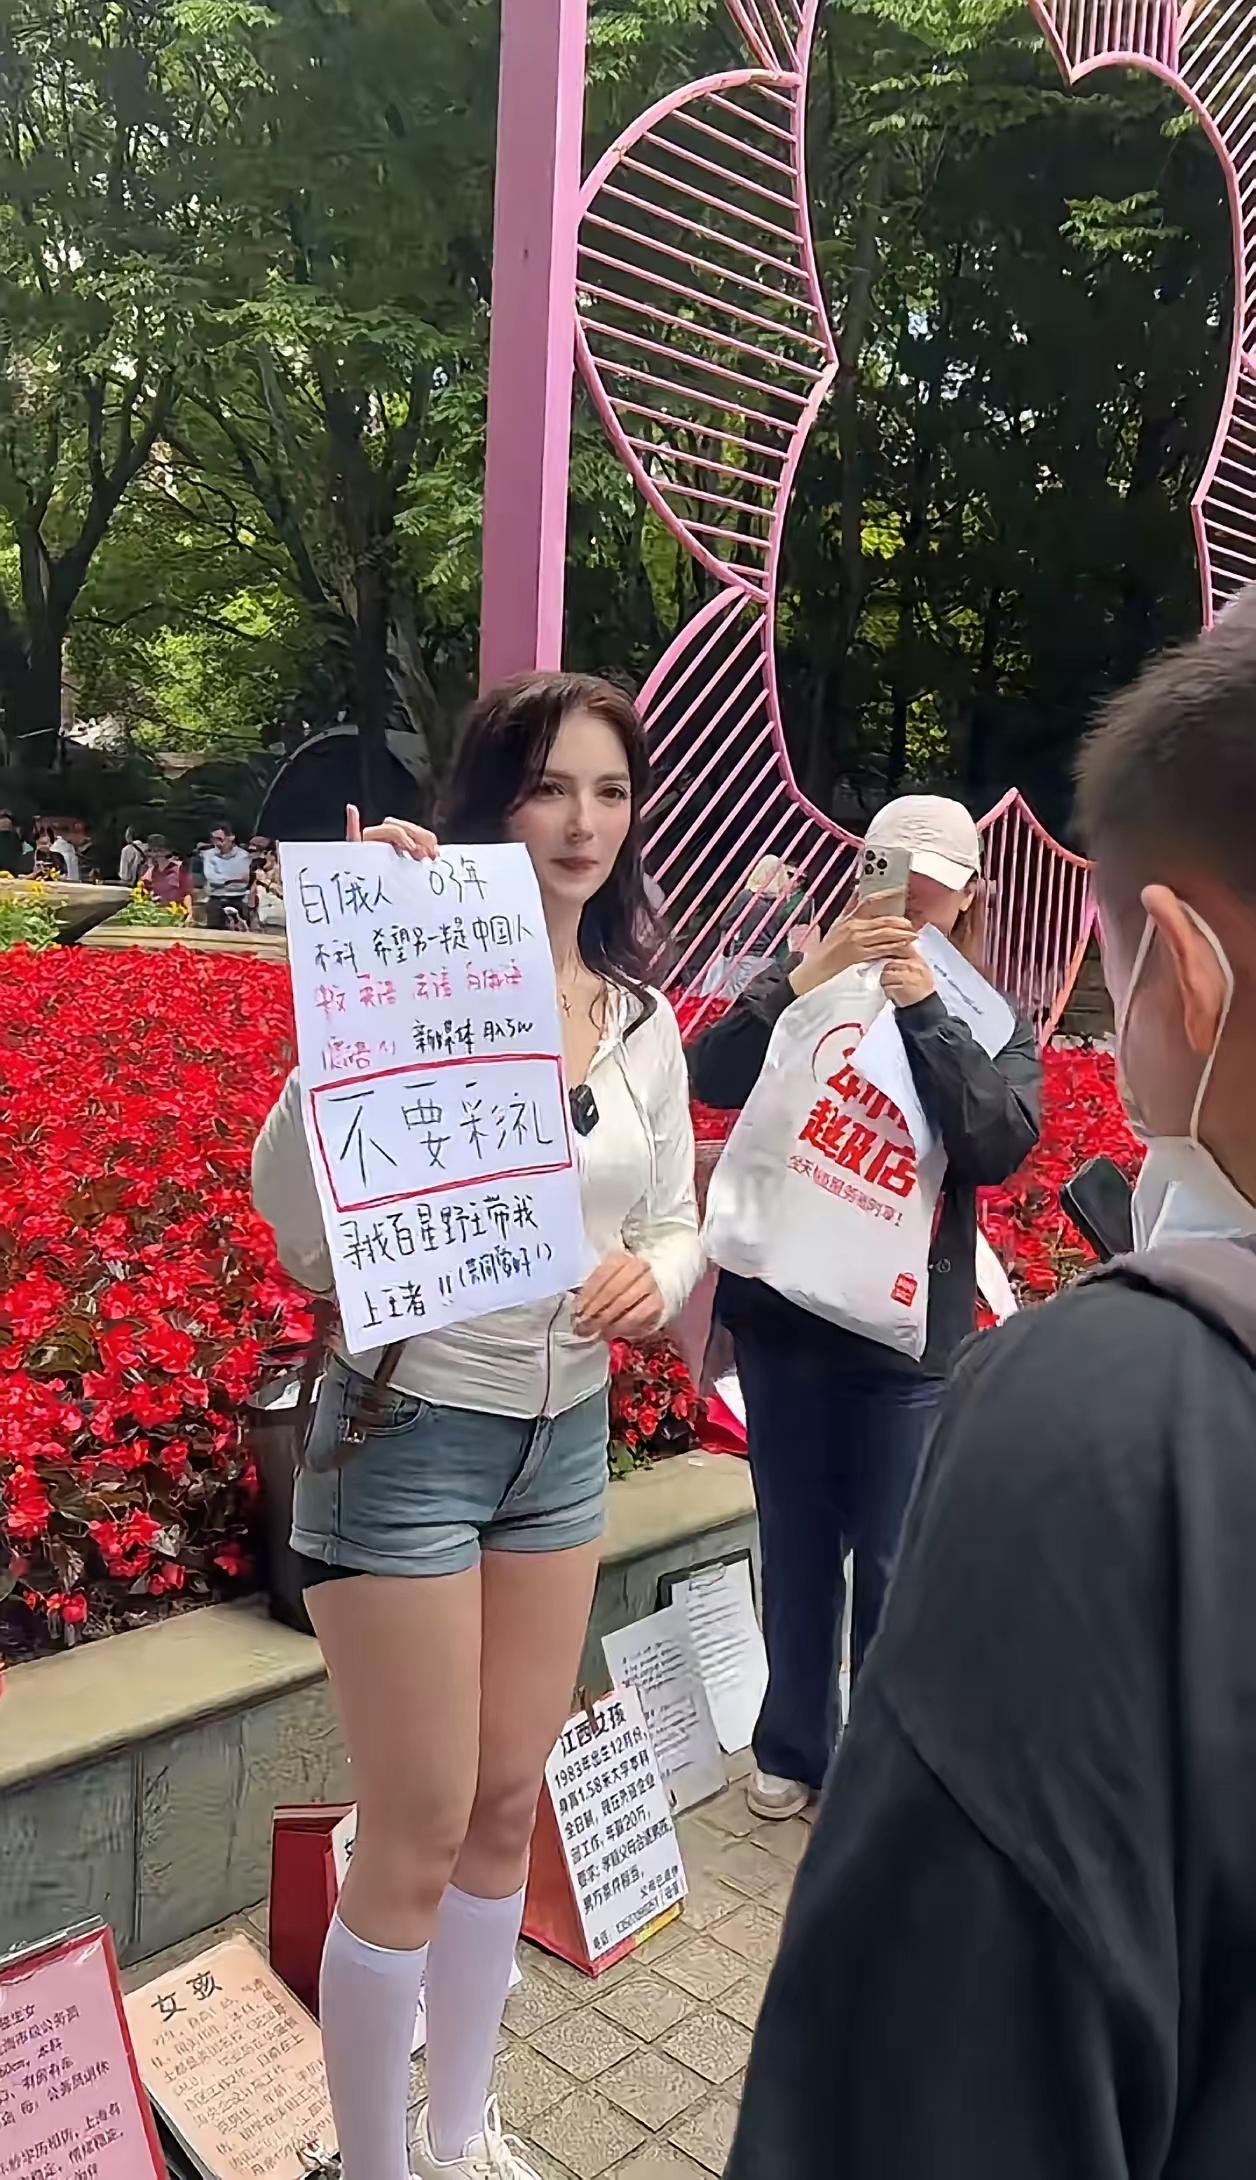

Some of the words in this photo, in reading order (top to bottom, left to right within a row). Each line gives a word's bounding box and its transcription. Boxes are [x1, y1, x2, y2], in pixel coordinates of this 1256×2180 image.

[372, 914, 535, 967] 希望另一半是中国人
[327, 1080, 554, 1189] 不要彩礼
[799, 1096, 918, 1199] 超级店
[151, 1970, 223, 2022] 女孩
